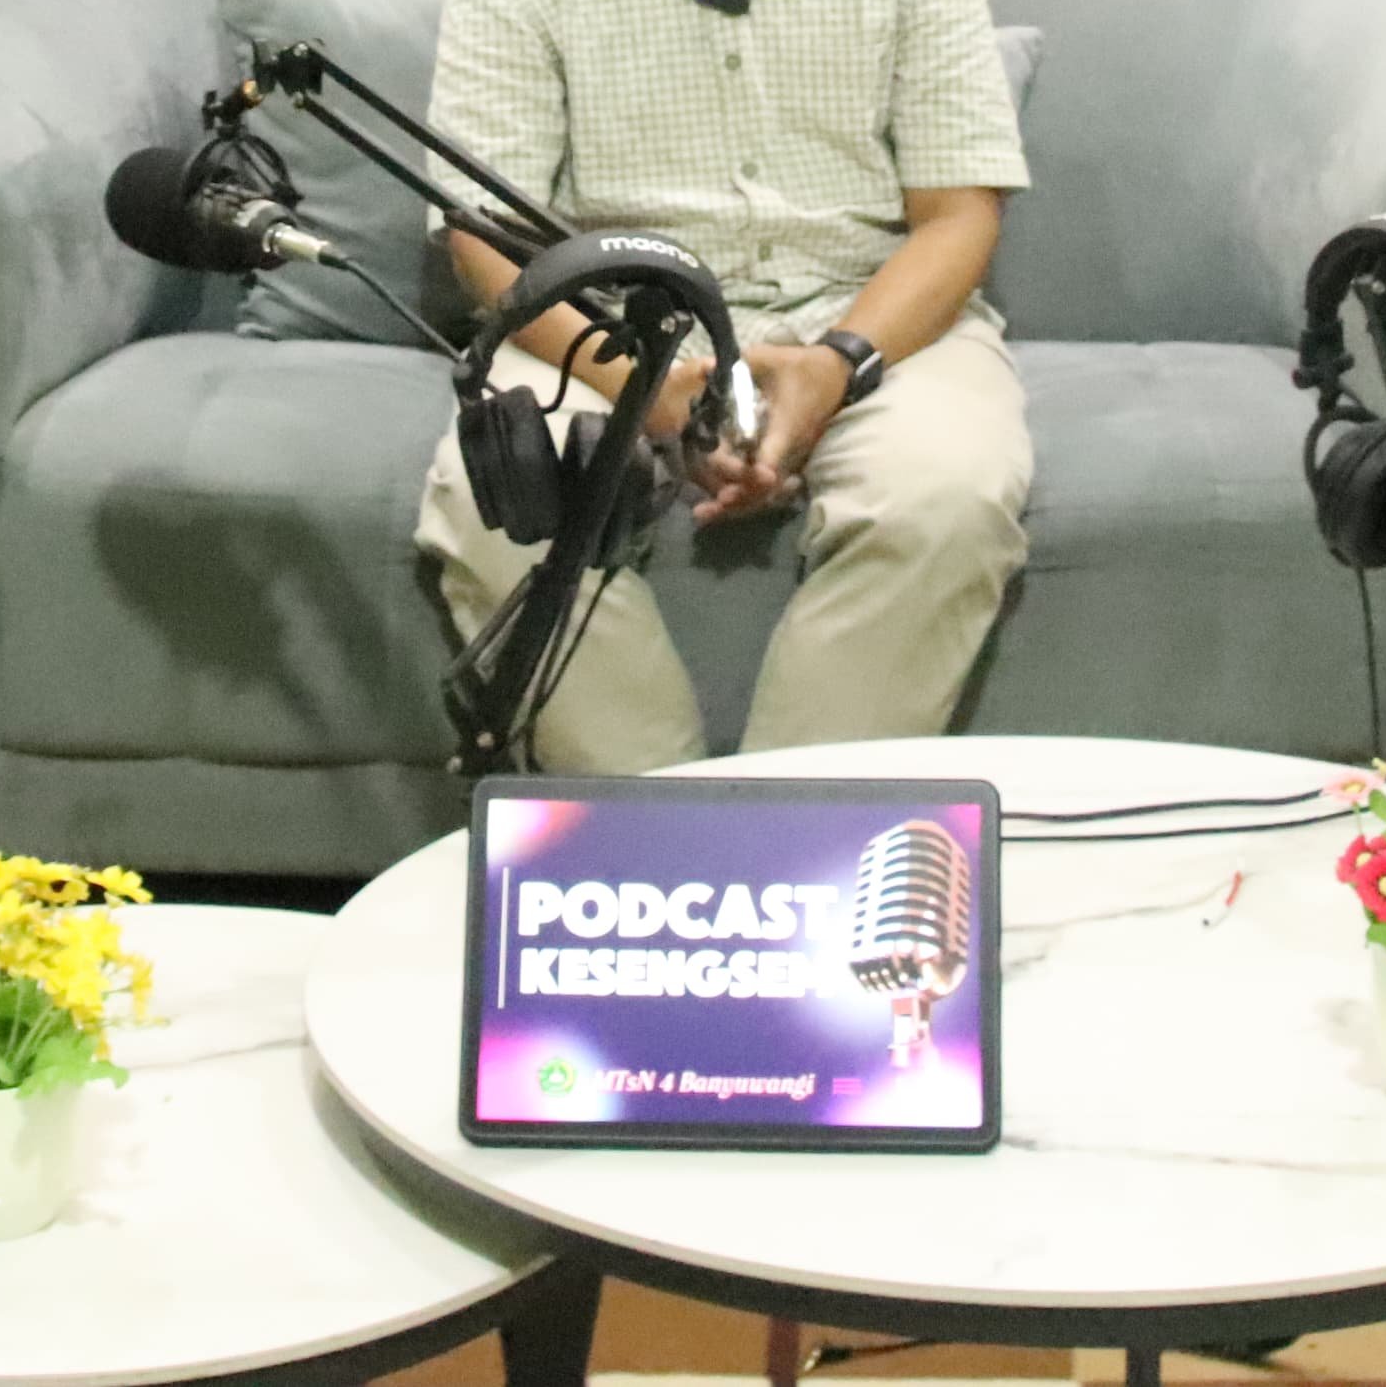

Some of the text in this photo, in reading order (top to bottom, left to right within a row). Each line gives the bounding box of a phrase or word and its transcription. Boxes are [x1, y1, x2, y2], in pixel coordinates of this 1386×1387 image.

[600, 236, 699, 268] maono
[518, 881, 839, 941] PODCAST
[659, 1072, 675, 1092] 4
[679, 1071, 815, 1101] Banyuwangi
